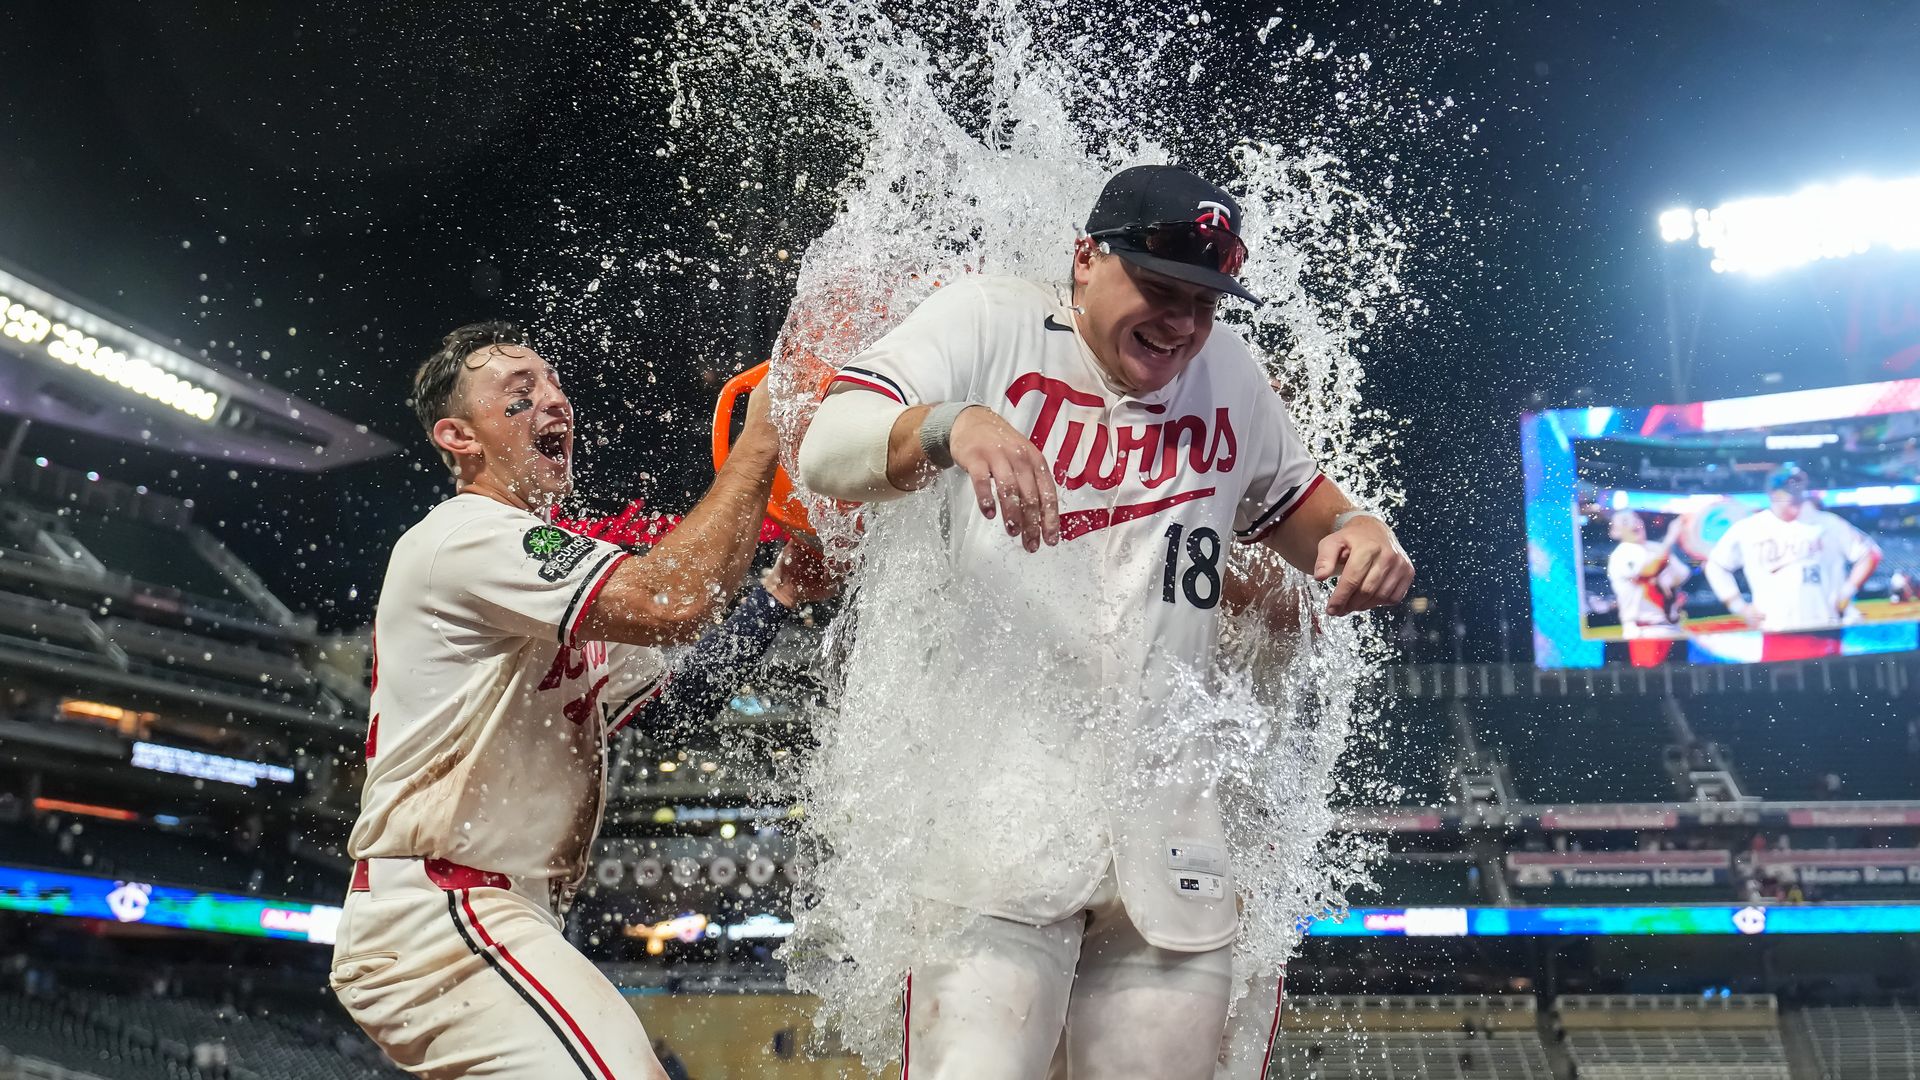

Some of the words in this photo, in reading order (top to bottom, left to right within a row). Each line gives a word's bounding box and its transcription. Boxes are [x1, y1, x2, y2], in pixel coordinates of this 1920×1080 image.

[1005, 371, 1238, 491] Twins
[1162, 522, 1221, 610] 18
[1653, 867, 1714, 885] Island
